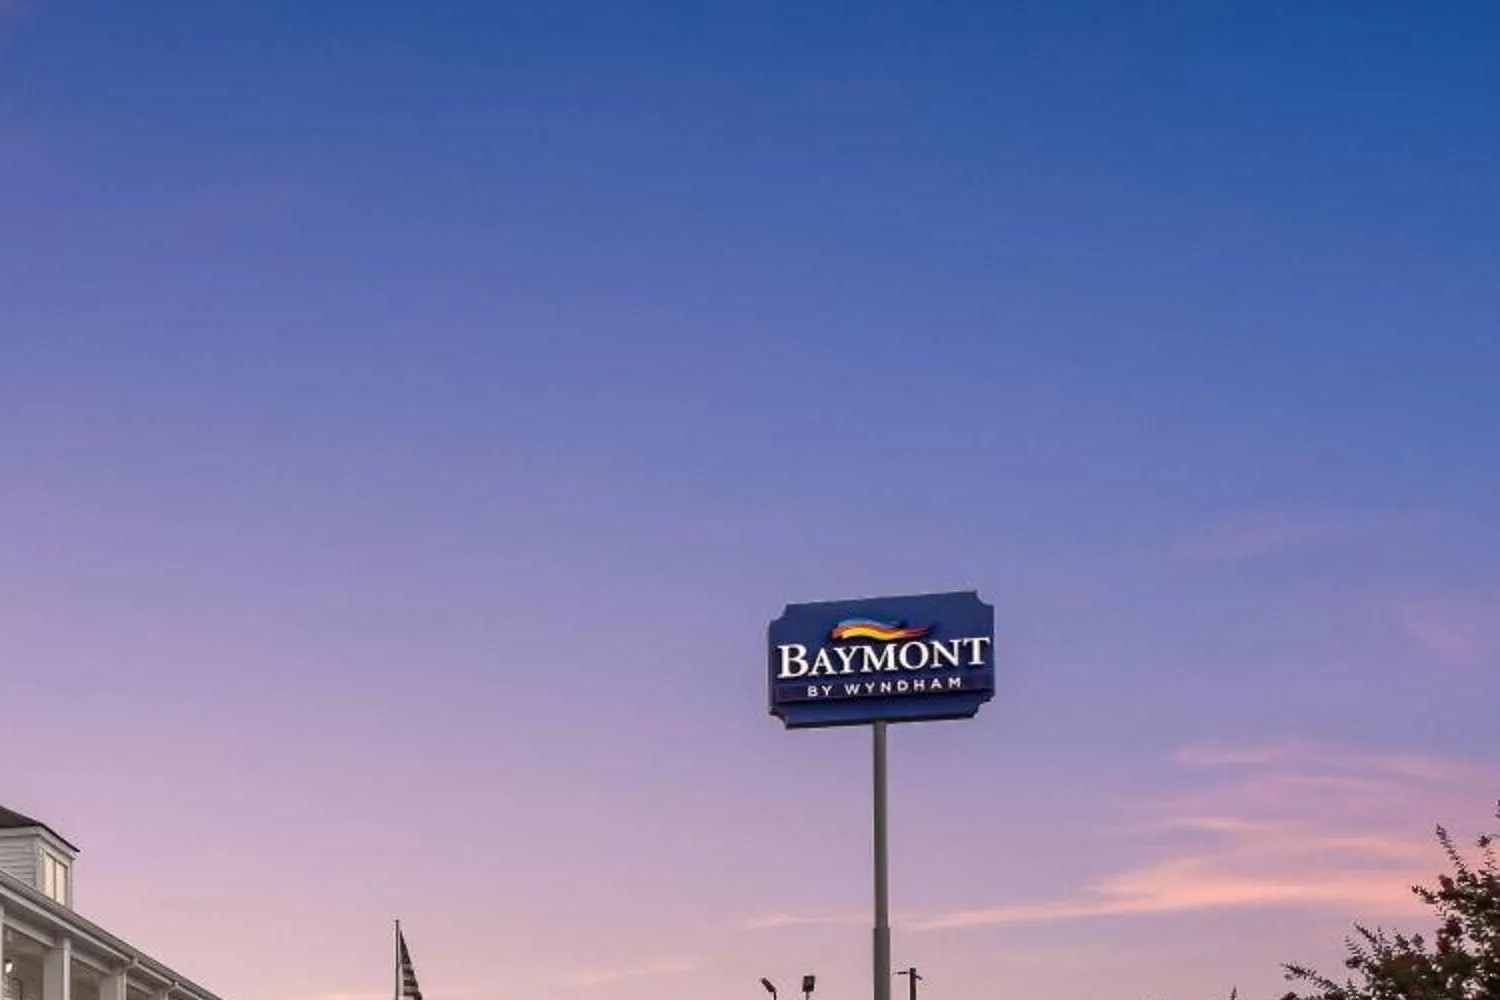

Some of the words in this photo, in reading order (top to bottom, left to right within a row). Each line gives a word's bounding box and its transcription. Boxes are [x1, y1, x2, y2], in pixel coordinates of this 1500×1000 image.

[777, 637, 990, 679] BAYMONT
[807, 685, 832, 697] BY
[845, 677, 962, 695] WYNDHAM
